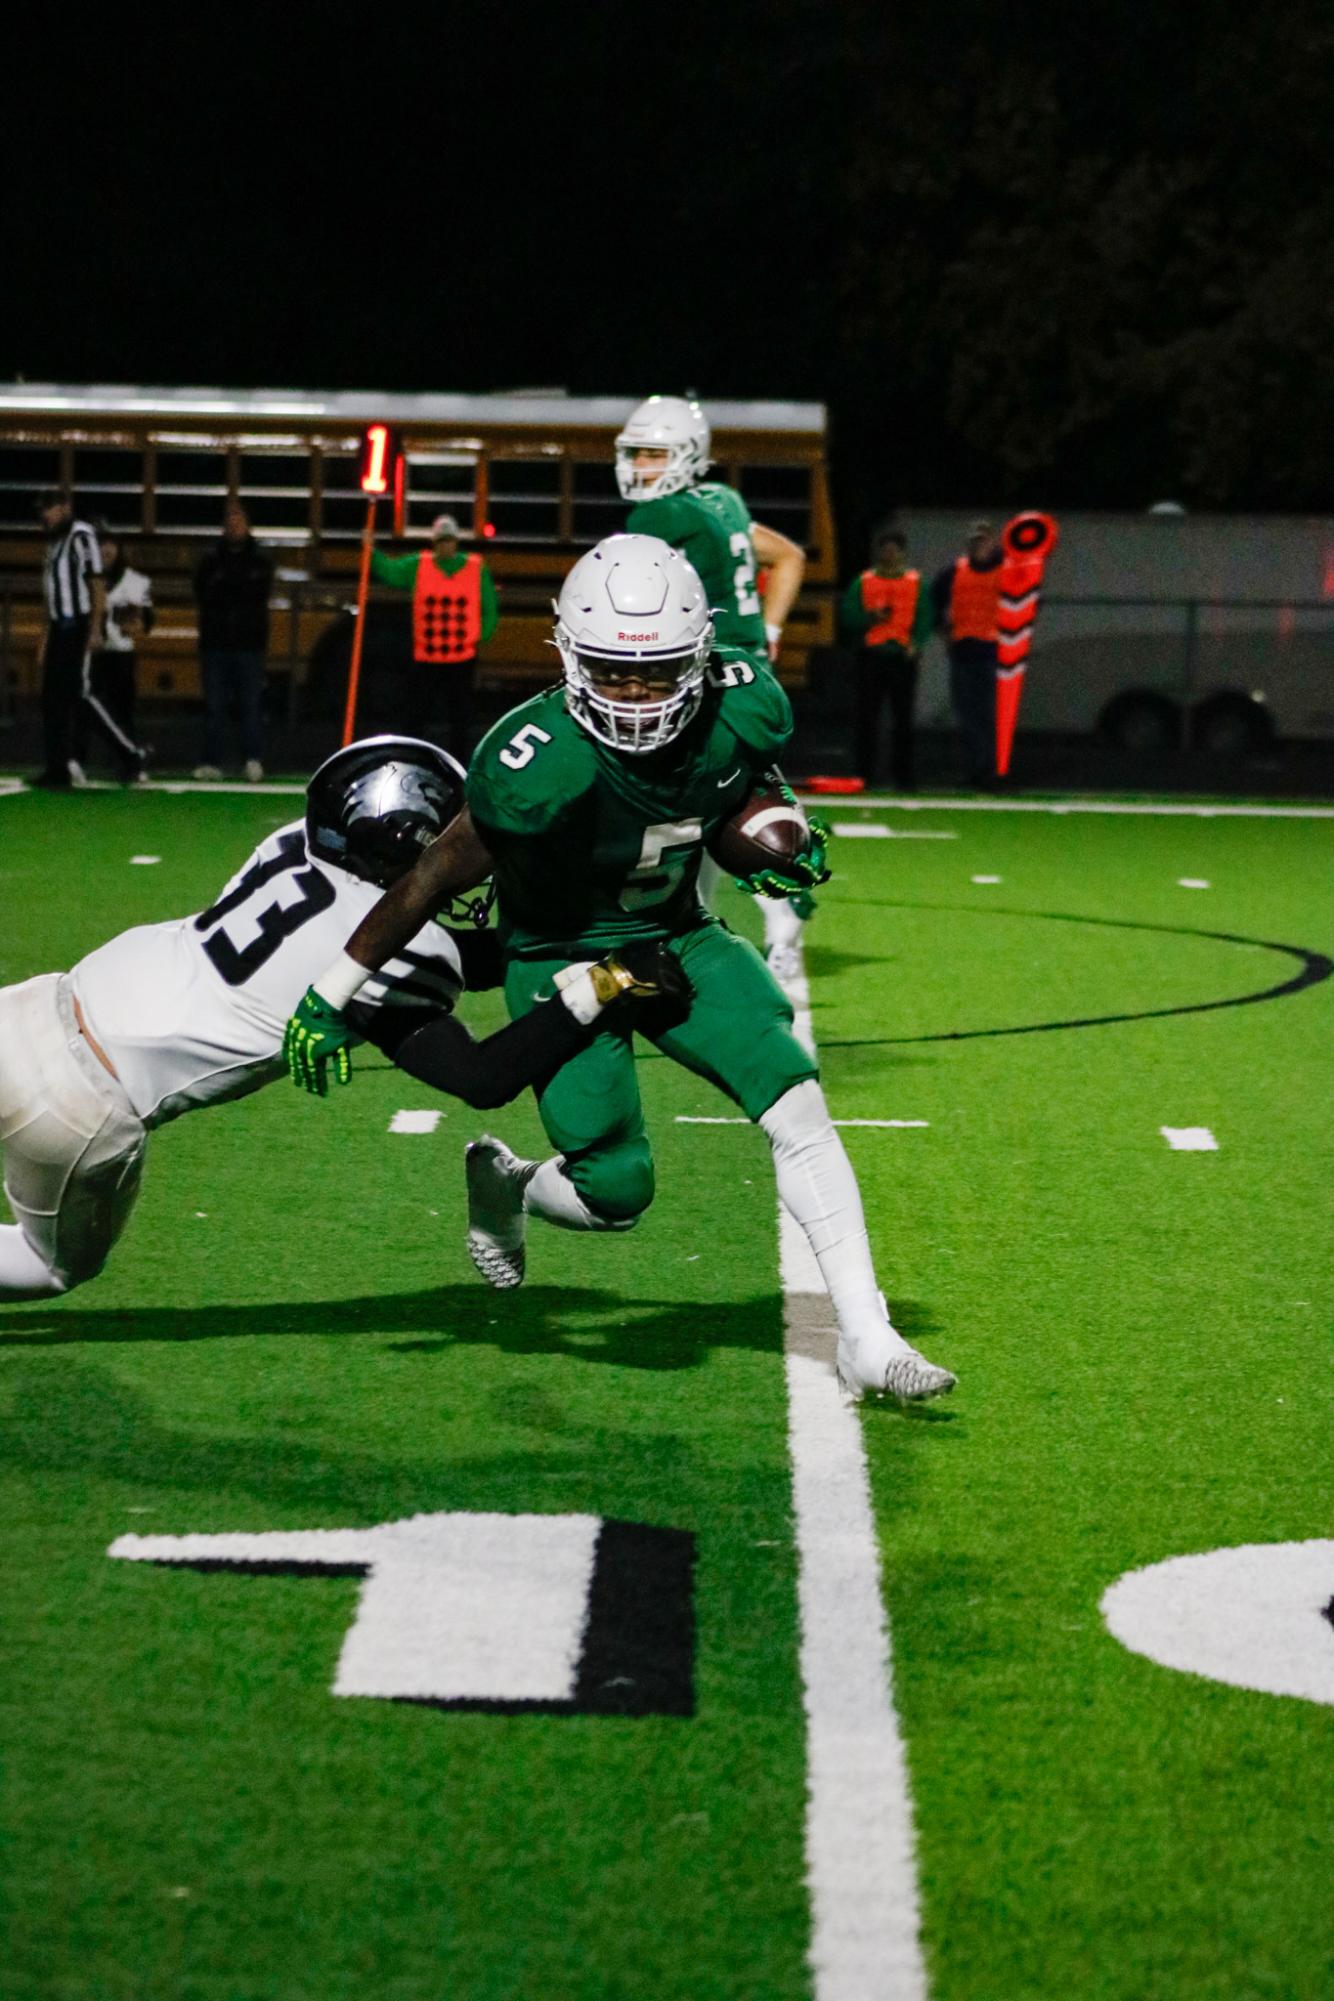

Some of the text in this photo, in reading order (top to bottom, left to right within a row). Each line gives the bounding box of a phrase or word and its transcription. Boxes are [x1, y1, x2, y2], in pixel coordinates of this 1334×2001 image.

[361, 425, 388, 494] 1
[617, 631, 659, 642] Riddell
[499, 722, 553, 770] 5
[617, 816, 704, 913] 5
